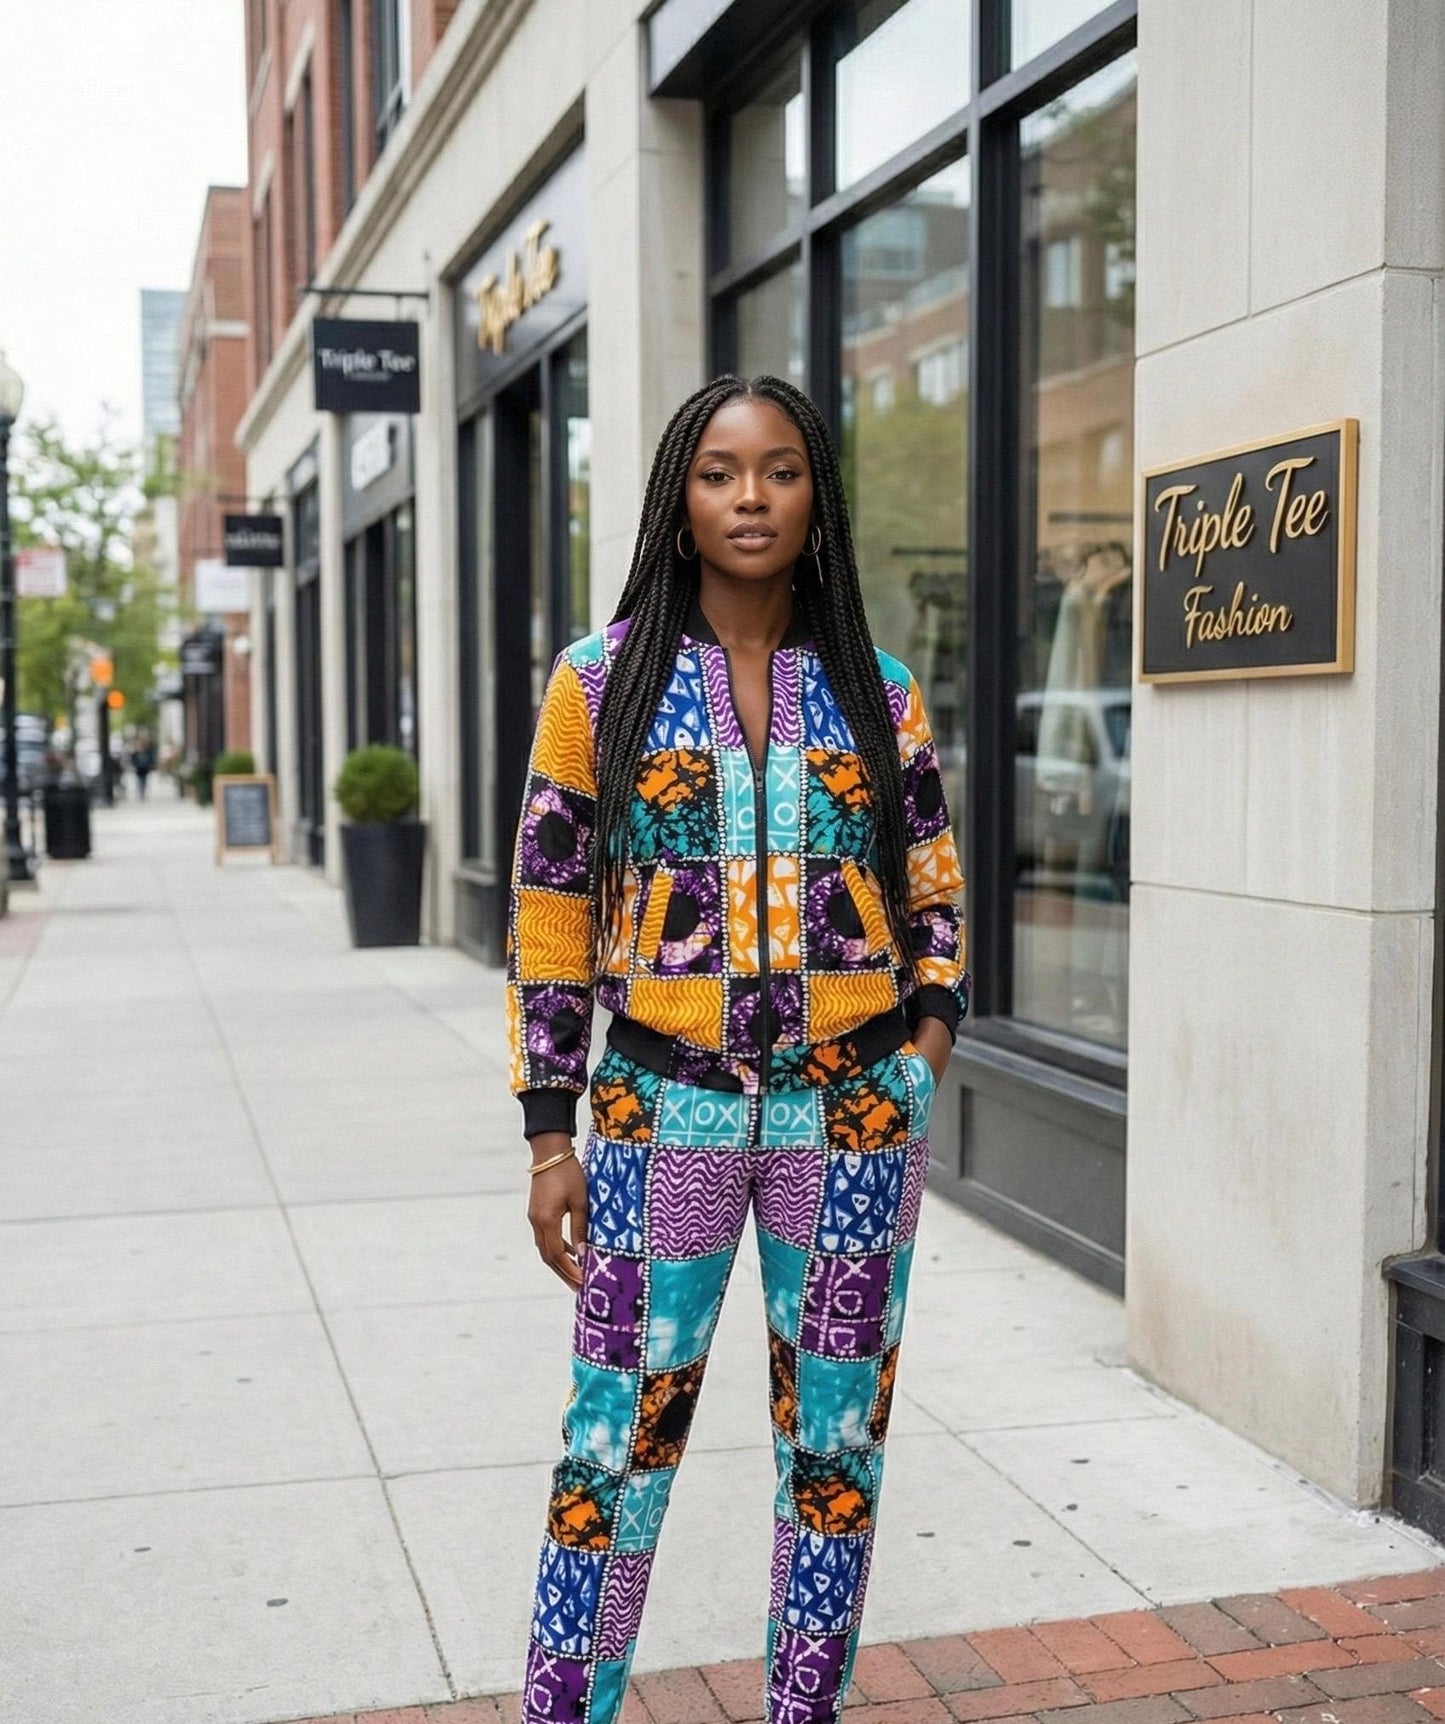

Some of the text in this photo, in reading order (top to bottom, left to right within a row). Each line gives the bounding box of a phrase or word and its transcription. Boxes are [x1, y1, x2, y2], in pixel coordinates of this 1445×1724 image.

[1154, 456, 1328, 577] Triple Tee
[1184, 581, 1293, 648] Fashion
